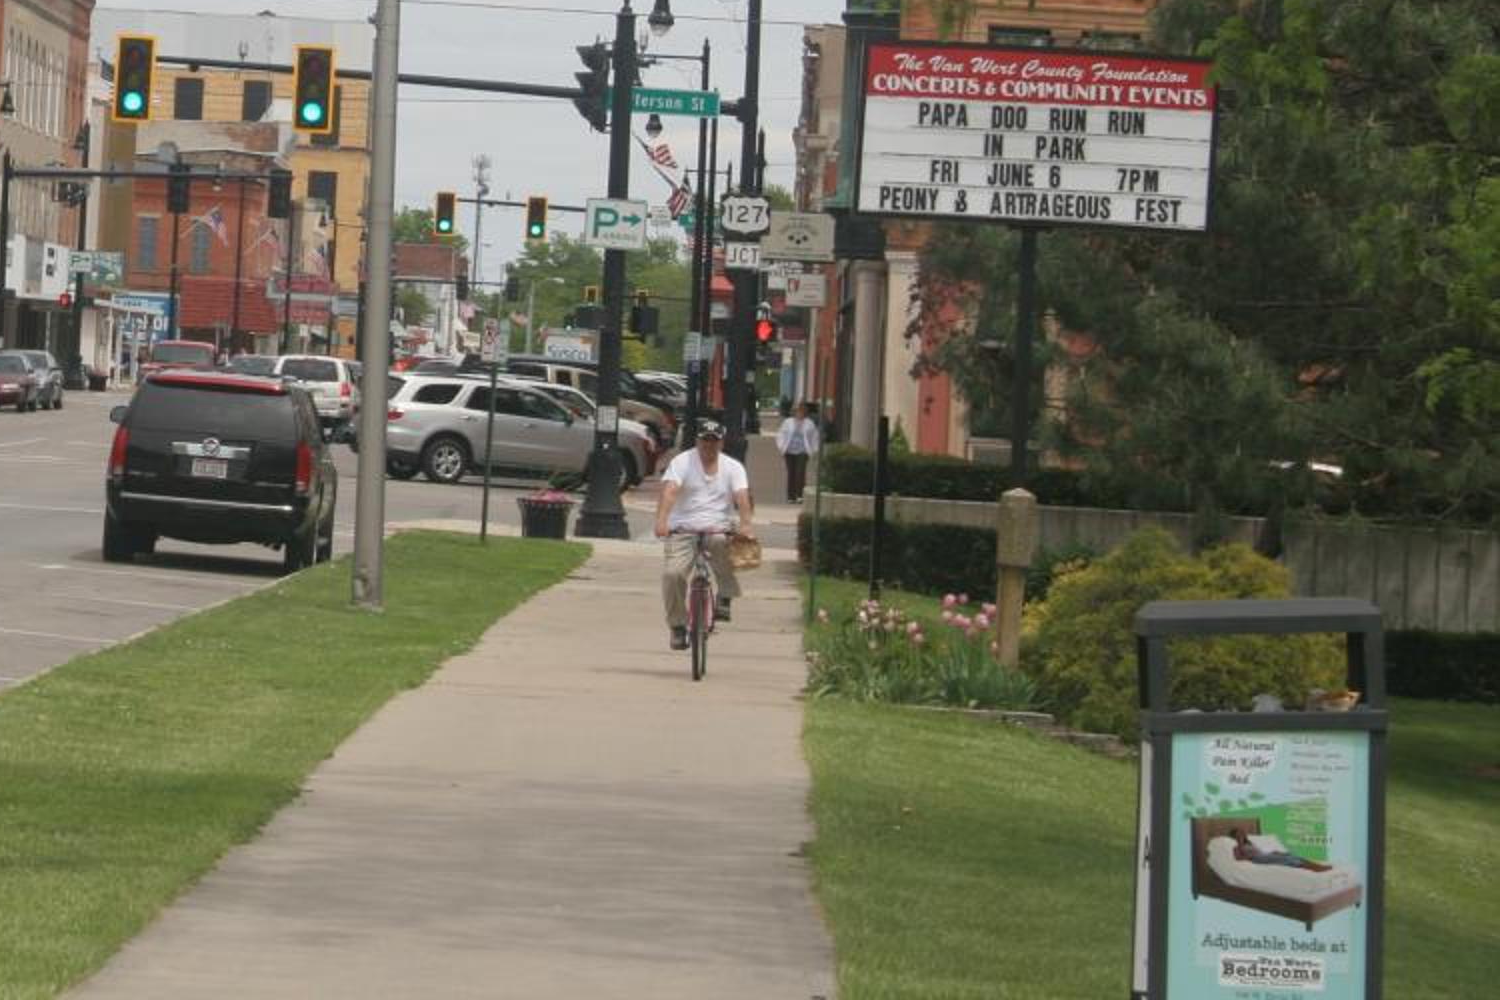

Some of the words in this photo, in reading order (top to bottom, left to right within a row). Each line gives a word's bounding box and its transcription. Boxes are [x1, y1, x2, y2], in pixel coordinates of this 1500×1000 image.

[893, 53, 925, 71] The
[929, 55, 964, 72] Van
[970, 57, 1019, 75] Wert
[1021, 59, 1084, 82] County
[1091, 62, 1188, 83] Foundation
[873, 73, 980, 95] CONCERTS
[984, 83, 996, 96] &
[1001, 79, 1124, 102] COMMUNITY
[1128, 86, 1207, 106] EVENTS
[691, 96, 705, 112] St
[918, 102, 968, 127] PAPA
[991, 106, 1027, 129] DOO
[1050, 108, 1087, 132] RUN
[1108, 110, 1145, 135] RUN
[983, 134, 1003, 157] IN
[1036, 135, 1086, 160] PARK
[930, 159, 959, 183] FRI
[987, 163, 1034, 187] JUNE
[1049, 165, 1061, 188] 6
[1117, 168, 1159, 193] 7PM
[726, 205, 764, 223] 127
[879, 186, 939, 211] PEONY
[990, 191, 1111, 219] ARTRAGEOUS
[1135, 197, 1182, 223] FEST
[728, 247, 759, 264] JCT
[1201, 932, 1287, 951] Adjustable
[1290, 936, 1326, 952] beds
[1331, 940, 1349, 953] at
[1222, 962, 1321, 980] Bedrooms
